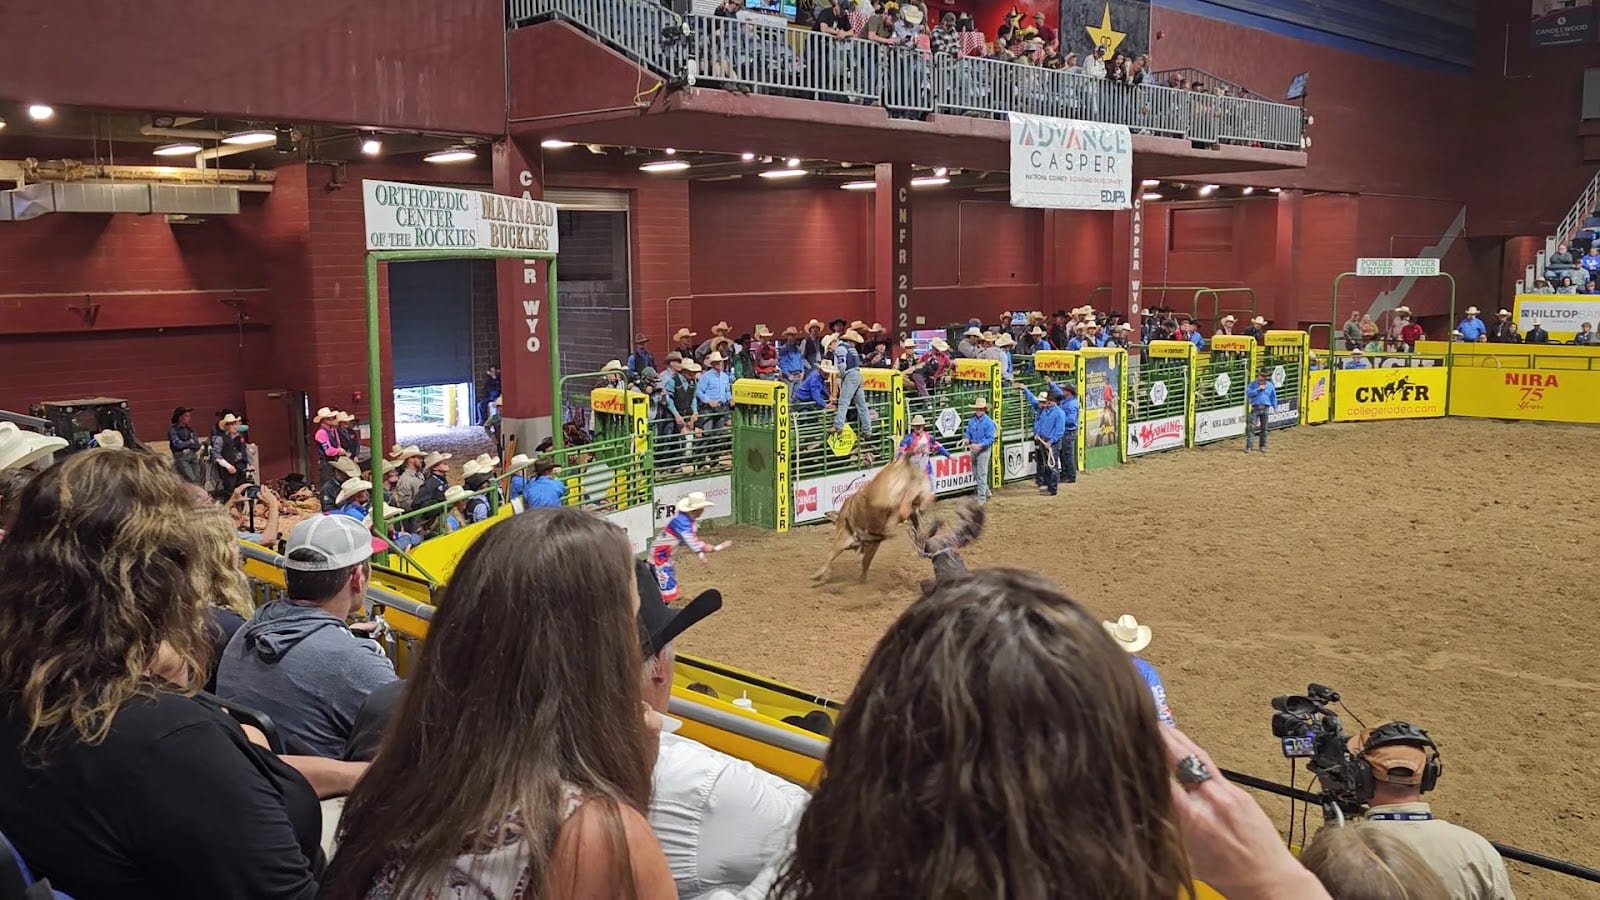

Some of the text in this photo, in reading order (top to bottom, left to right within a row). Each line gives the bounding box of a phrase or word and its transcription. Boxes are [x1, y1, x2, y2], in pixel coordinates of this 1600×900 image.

[1535, 24, 1588, 35] CANDLEWOOD
[1018, 121, 1127, 154] ADVANCE
[1030, 150, 1116, 173] CASPER
[375, 184, 469, 211] ORTHOPEDIC
[395, 206, 455, 228] CENTER
[480, 194, 554, 227] MAYNARD
[370, 227, 476, 247] OF THE ROCKIES
[489, 222, 549, 250] BUCKLES
[898, 187, 908, 346] CNFR 2023
[1131, 199, 1141, 314] CASPER WYO
[1530, 309, 1579, 318] HILLTOP
[522, 299, 541, 352] WYO
[1504, 372, 1559, 387] NIRA
[1355, 385, 1430, 403] CNFR
[1520, 387, 1545, 401] 75
[1347, 404, 1438, 417] collegerodeo.com
[778, 392, 787, 530] POWDER RIVER
[936, 454, 972, 478] NIR
